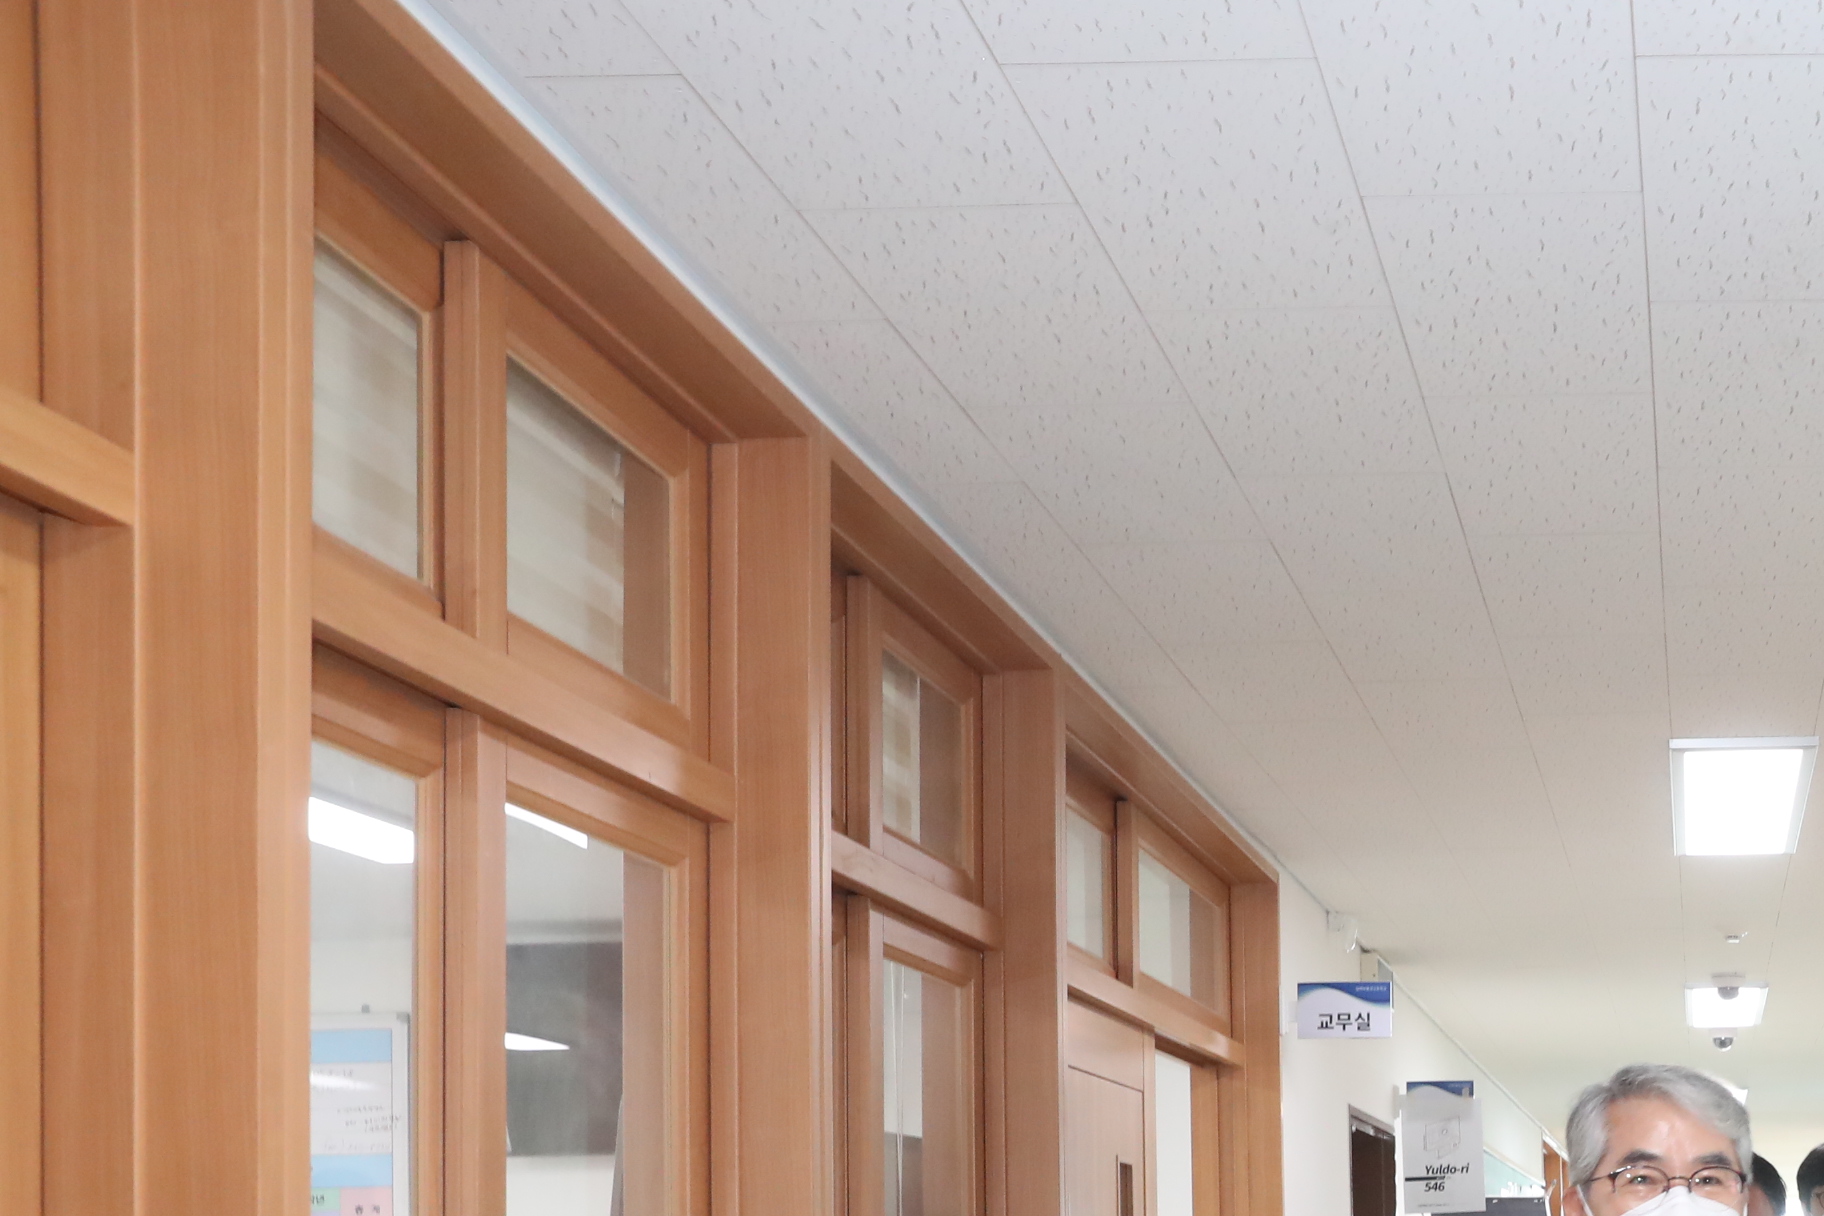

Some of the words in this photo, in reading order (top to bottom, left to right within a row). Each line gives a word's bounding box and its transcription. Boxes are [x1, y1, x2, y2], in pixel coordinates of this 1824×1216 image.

[1317, 1012, 1371, 1031] 교무실
[1425, 1162, 1470, 1176] Yuldo-ri
[1424, 1181, 1446, 1193] 546
